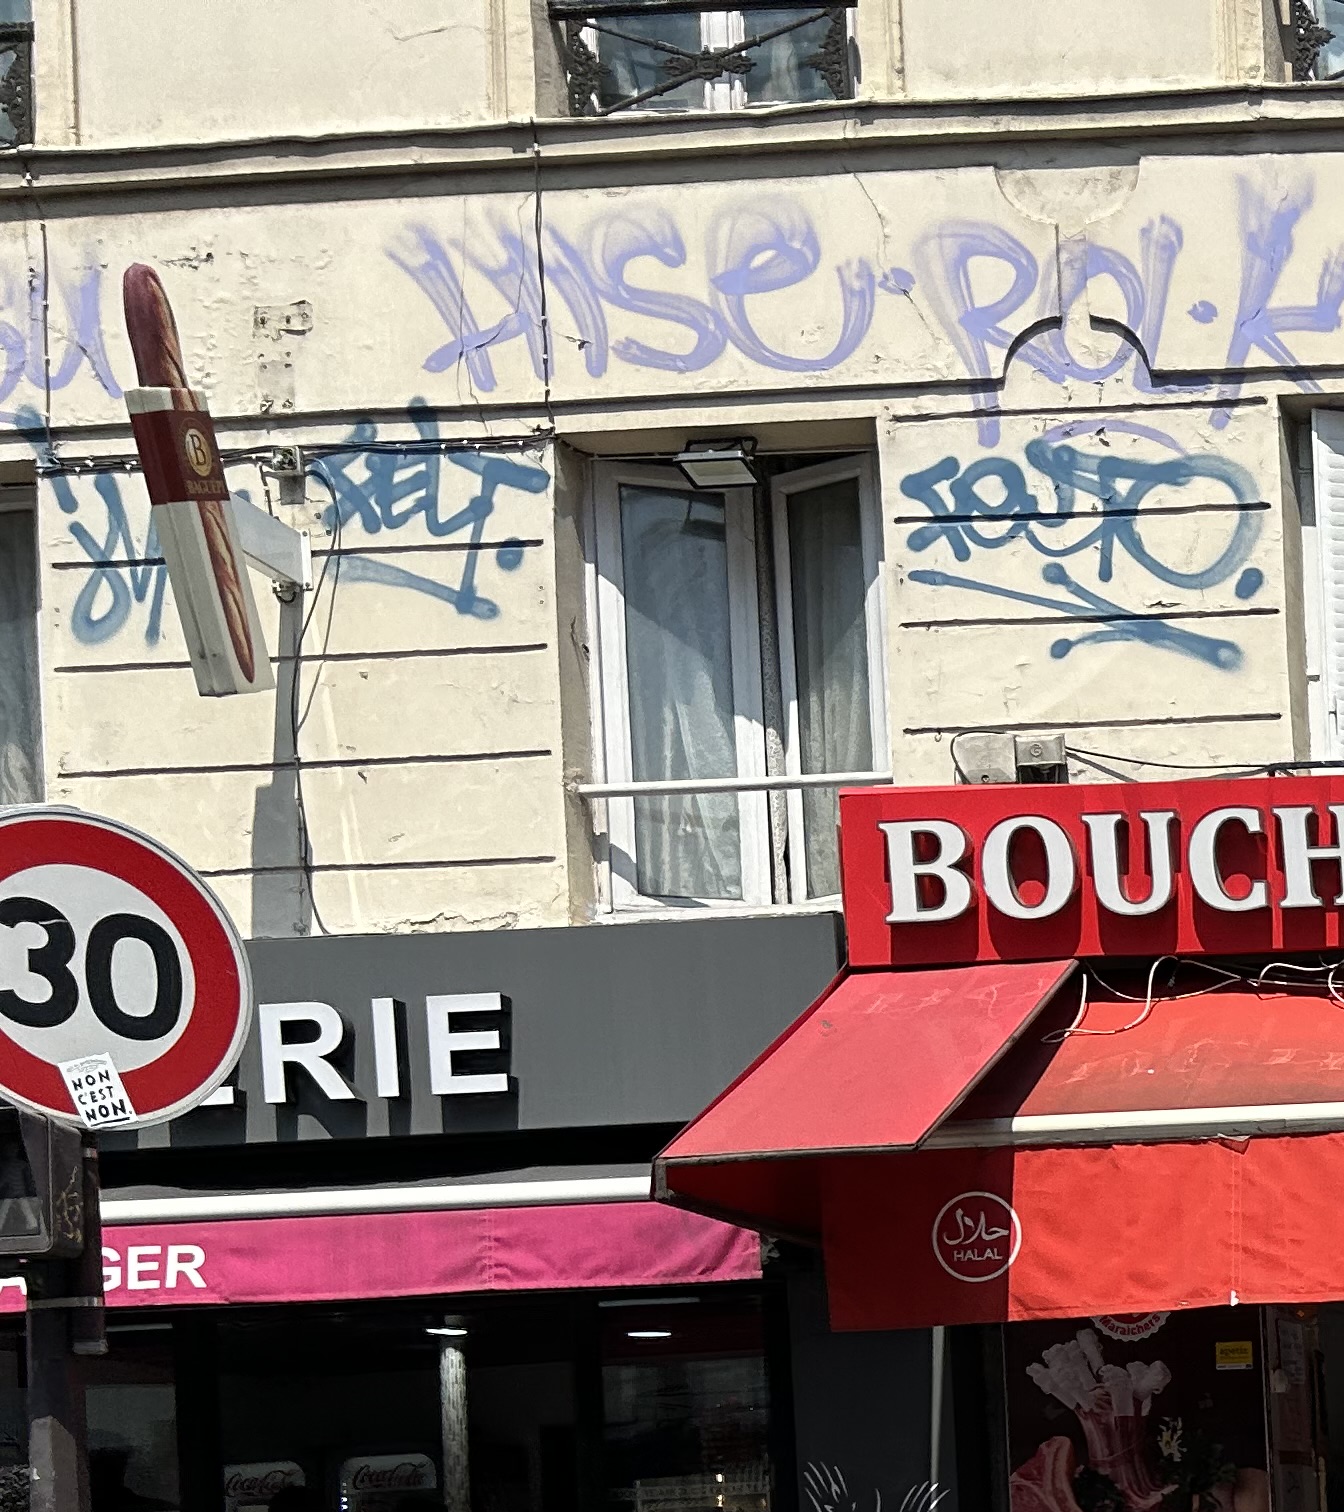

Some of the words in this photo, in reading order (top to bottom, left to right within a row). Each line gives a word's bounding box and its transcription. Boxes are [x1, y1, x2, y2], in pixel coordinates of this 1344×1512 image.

[0, 896, 184, 1041] 30
[200, 992, 510, 1106] RIE
[71, 1069, 111, 1091] NON
[77, 1085, 113, 1105] C'EST
[943, 1207, 1010, 1246] حلال
[953, 1248, 1004, 1262] HALAL
